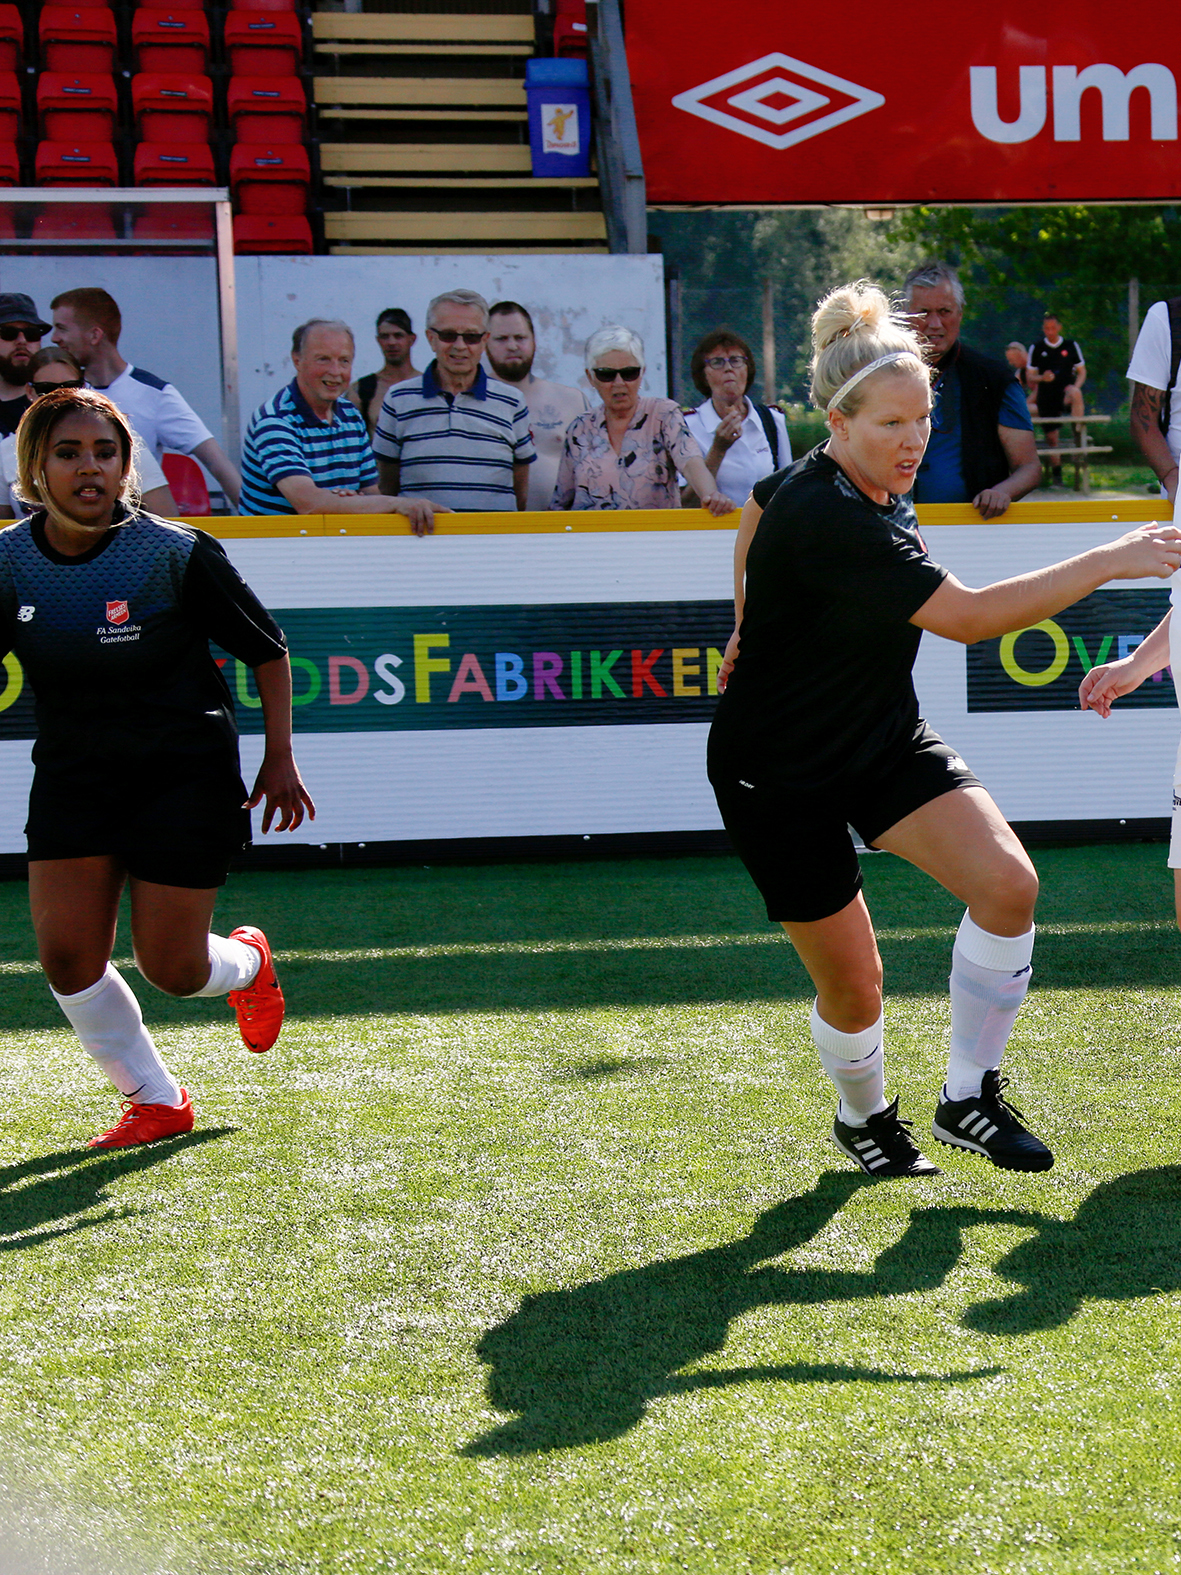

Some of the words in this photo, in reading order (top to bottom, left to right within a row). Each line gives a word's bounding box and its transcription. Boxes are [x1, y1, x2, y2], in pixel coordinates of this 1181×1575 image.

[97, 627, 106, 635] FA
[107, 624, 142, 634] Sandvika
[100, 633, 140, 644] Gatefotball
